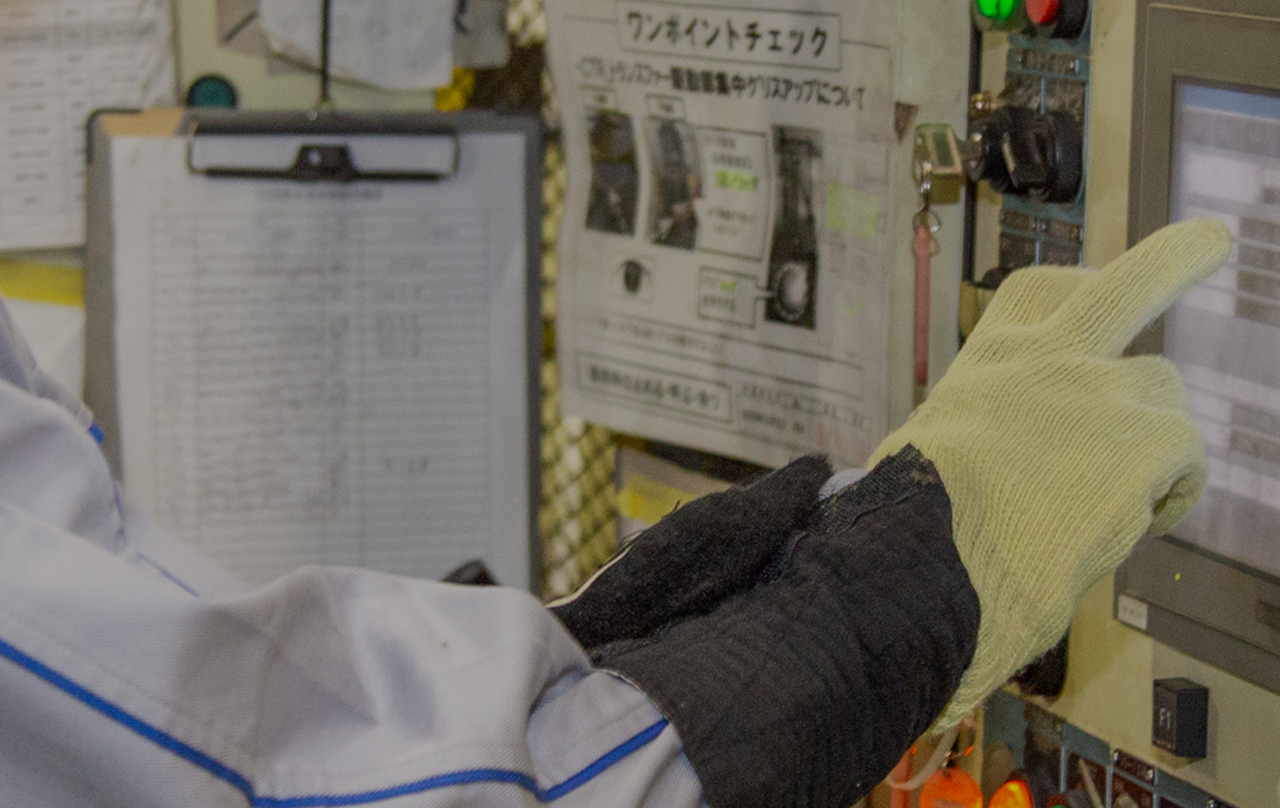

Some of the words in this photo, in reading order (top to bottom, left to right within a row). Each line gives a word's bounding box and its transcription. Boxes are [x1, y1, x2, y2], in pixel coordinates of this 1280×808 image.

[626, 10, 828, 57] ワンポイントチェック
